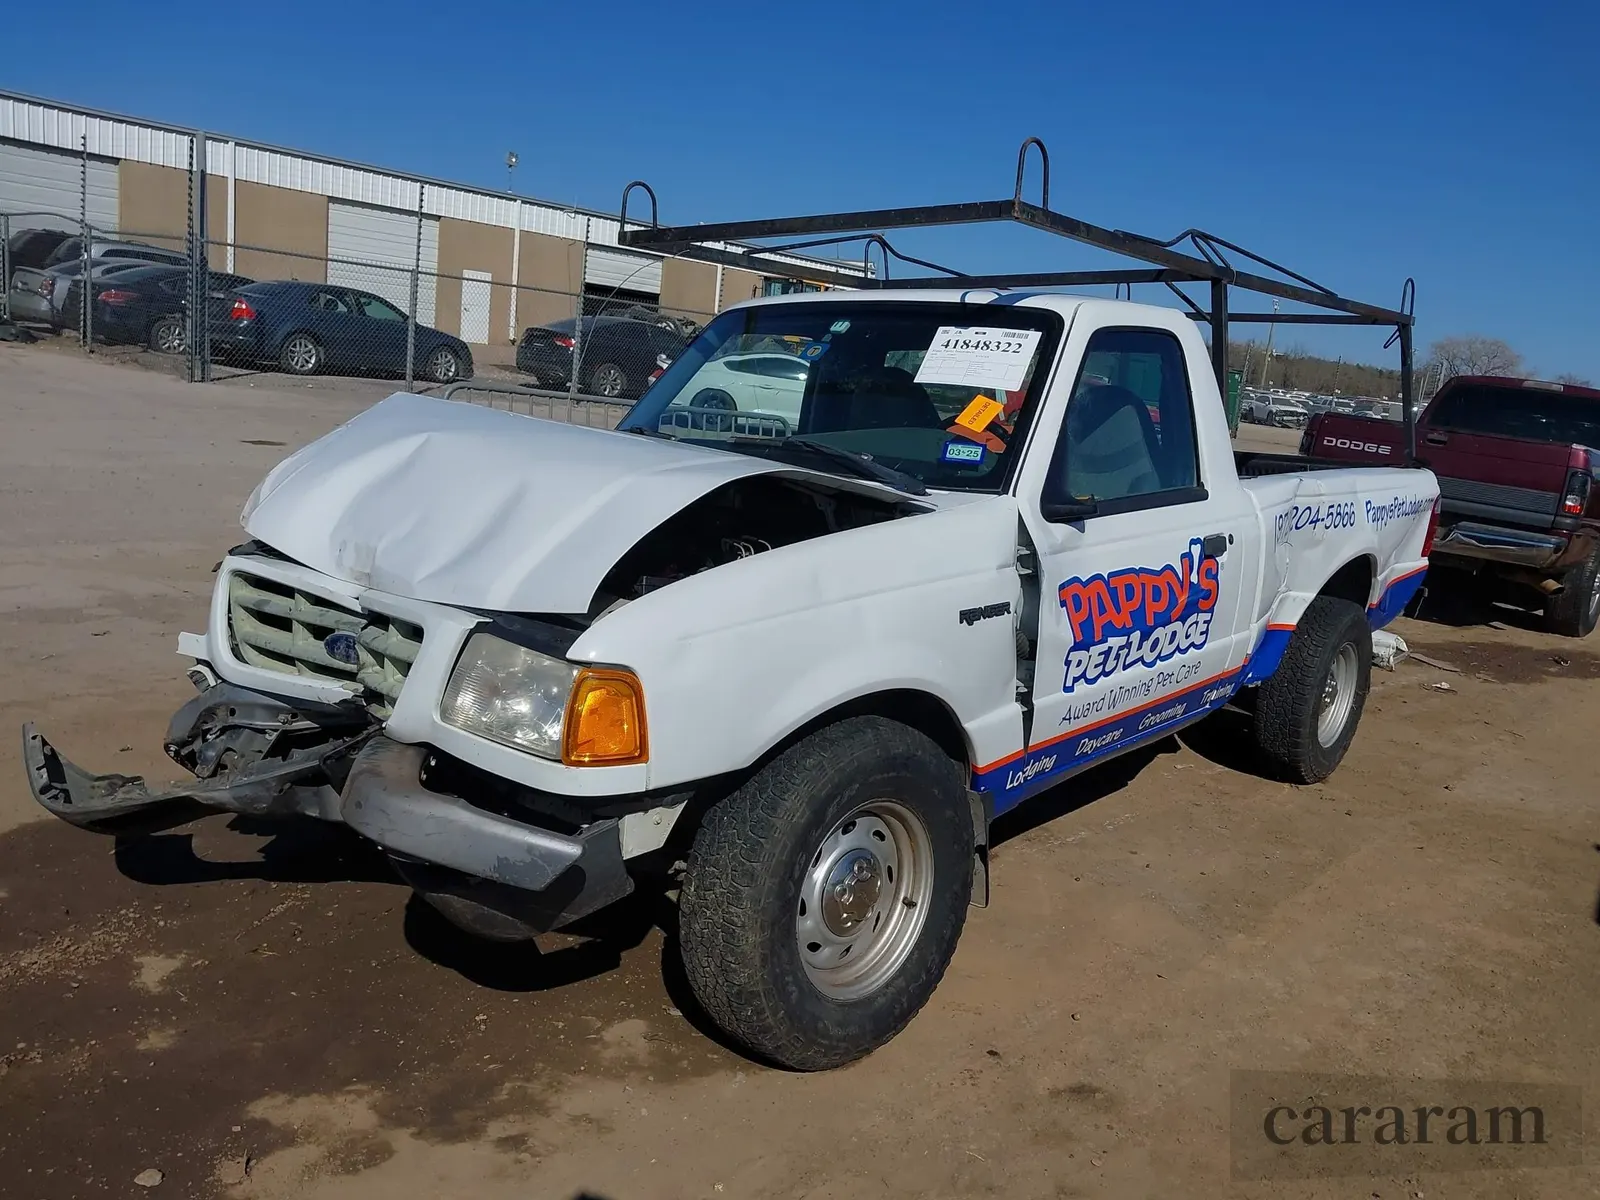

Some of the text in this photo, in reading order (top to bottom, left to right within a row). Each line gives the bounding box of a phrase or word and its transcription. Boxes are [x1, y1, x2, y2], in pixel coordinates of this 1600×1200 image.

[941, 339, 1022, 354] 41848322
[968, 402, 991, 425] DETAILED
[1323, 437, 1392, 455] DODGE
[1060, 542, 1217, 641] PAPPY'S
[959, 601, 1012, 627] RANGER
[1059, 661, 1201, 726] Award Winning Pet Care
[1005, 754, 1058, 790] Lodging
[1075, 728, 1124, 756] Daycare
[1138, 701, 1187, 731] Grooming
